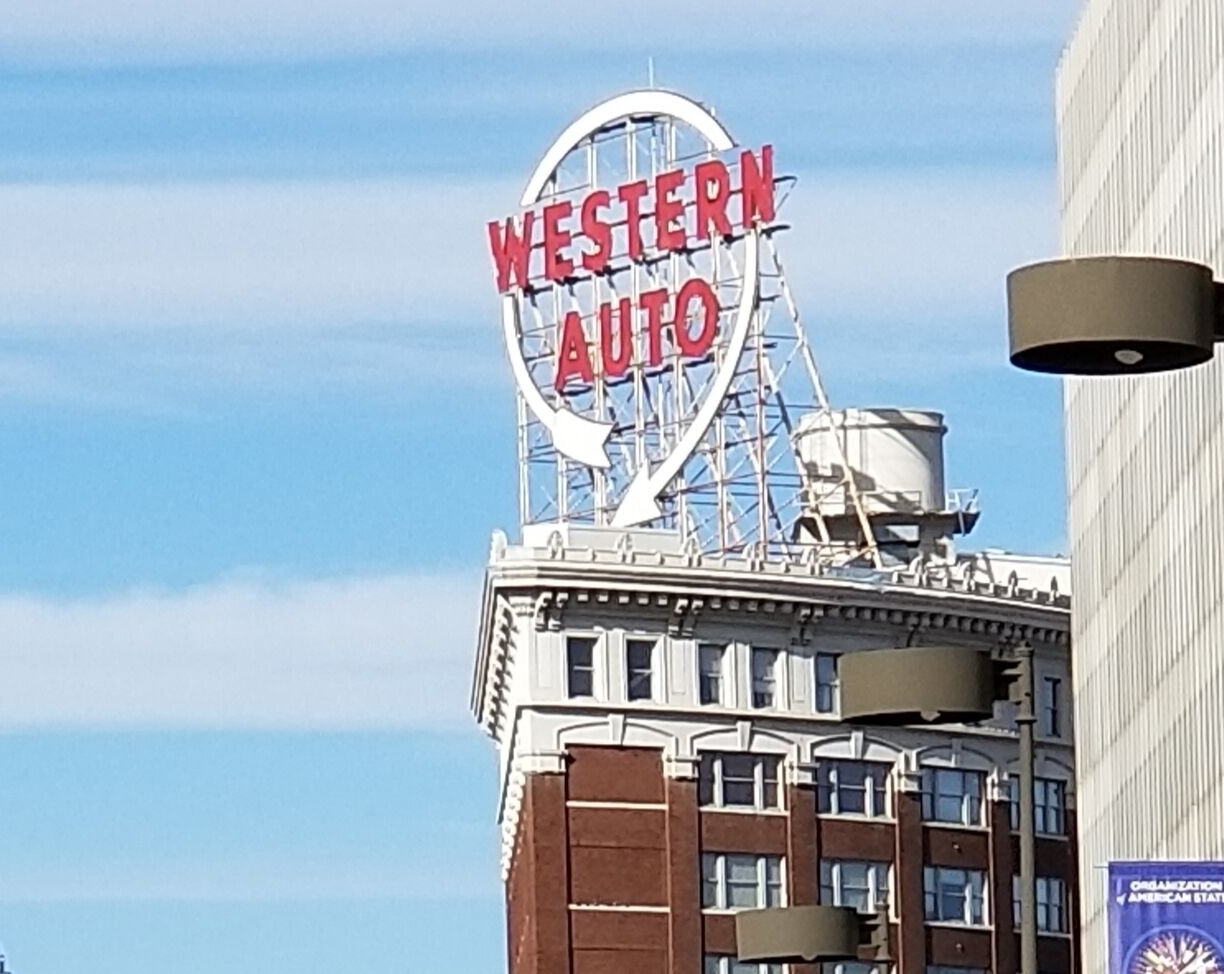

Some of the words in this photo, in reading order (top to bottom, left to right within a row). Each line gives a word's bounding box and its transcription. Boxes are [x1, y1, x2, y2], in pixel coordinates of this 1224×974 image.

[488, 145, 776, 295] WESTERN
[555, 278, 721, 392] AUTO
[1128, 892, 1192, 903] AMERICAN
[1130, 880, 1223, 891] ORGANIZATION
